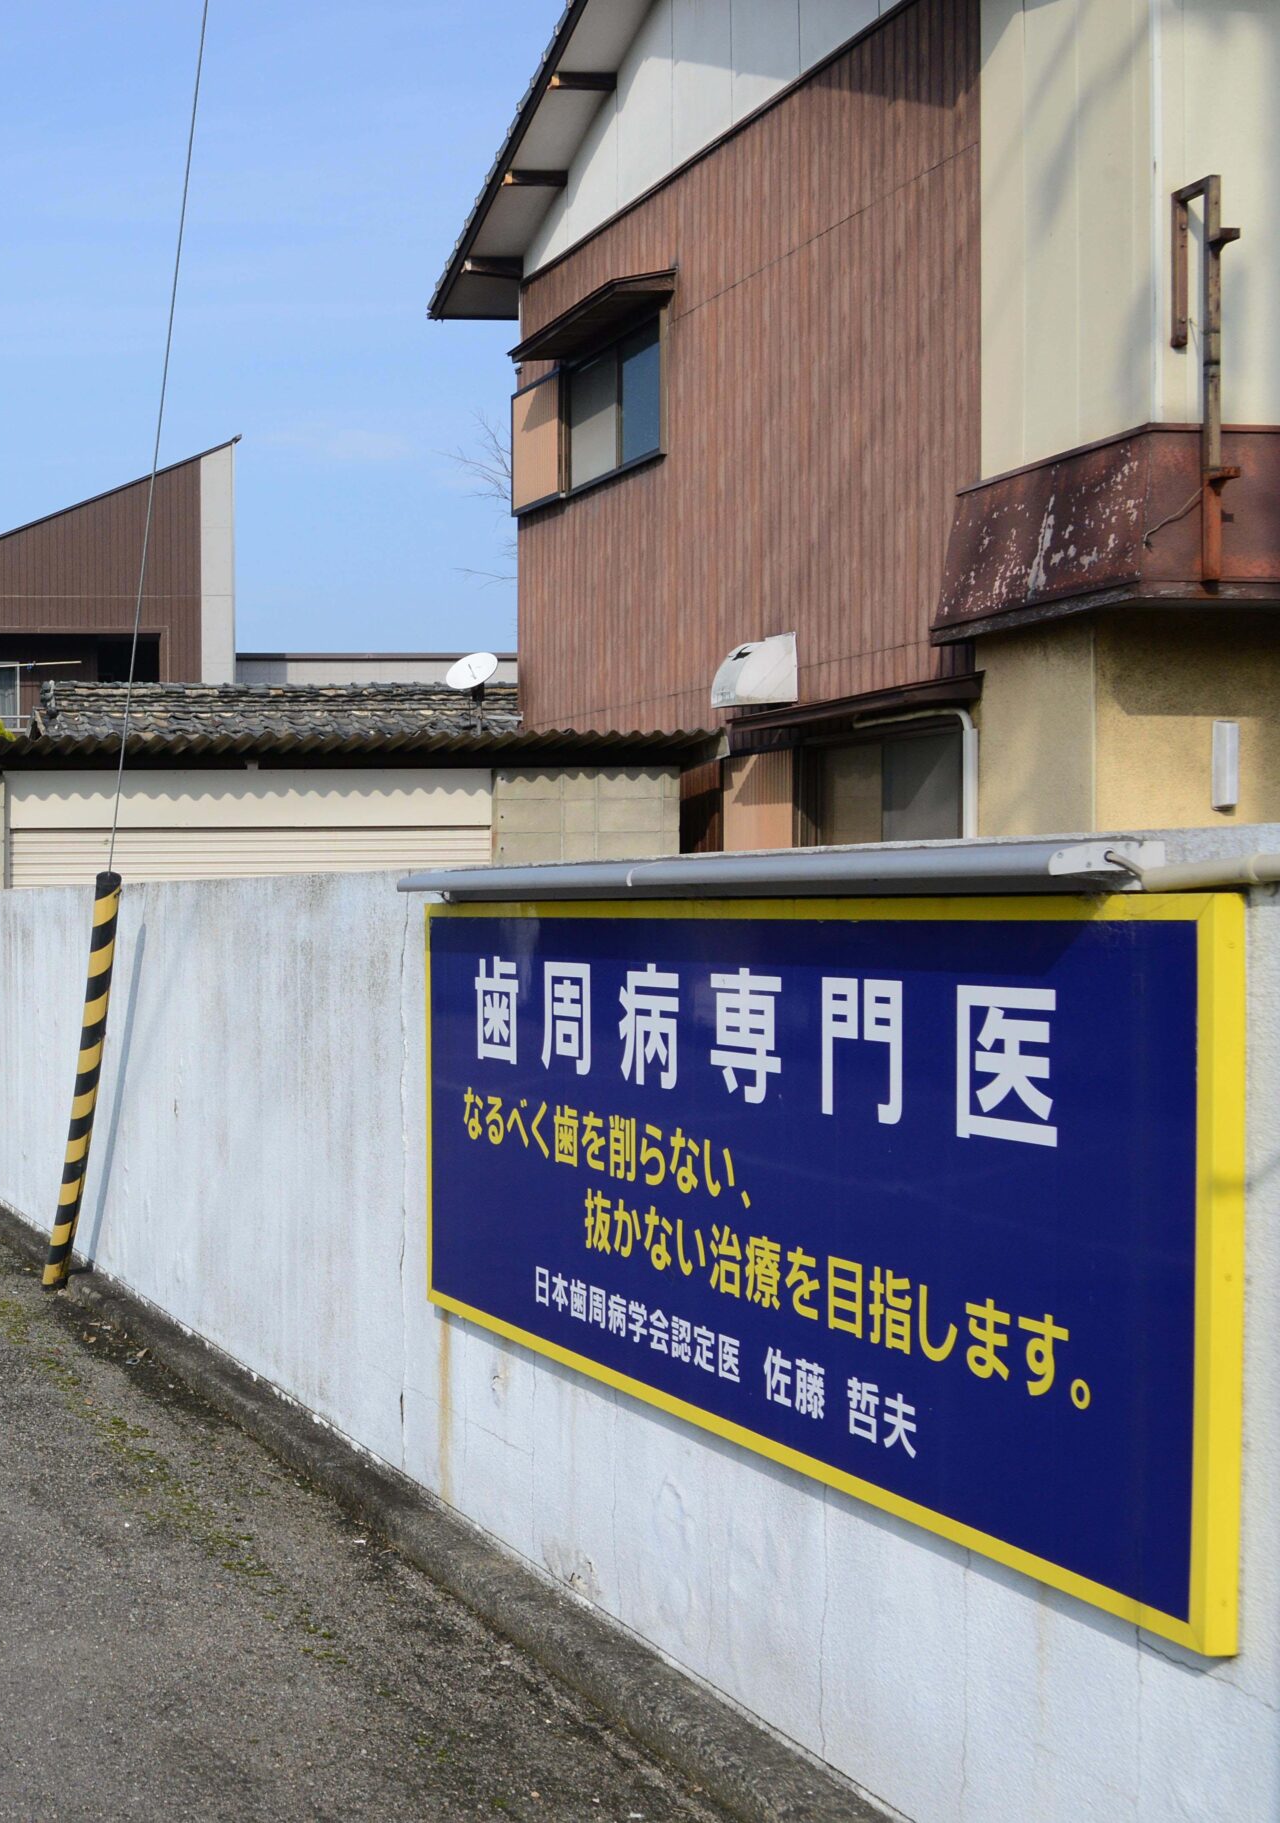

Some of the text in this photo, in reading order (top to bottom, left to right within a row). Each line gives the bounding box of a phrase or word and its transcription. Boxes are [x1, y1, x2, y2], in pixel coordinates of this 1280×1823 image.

[463, 1087, 751, 1209] なるべく歯を削らない、
[475, 956, 1058, 1148] 歯周病専門医
[535, 1266, 918, 1459] 日本歯周病学会認定医 佐藤 哲夫
[585, 1188, 1091, 1410] 抜かない治療を目指します。
